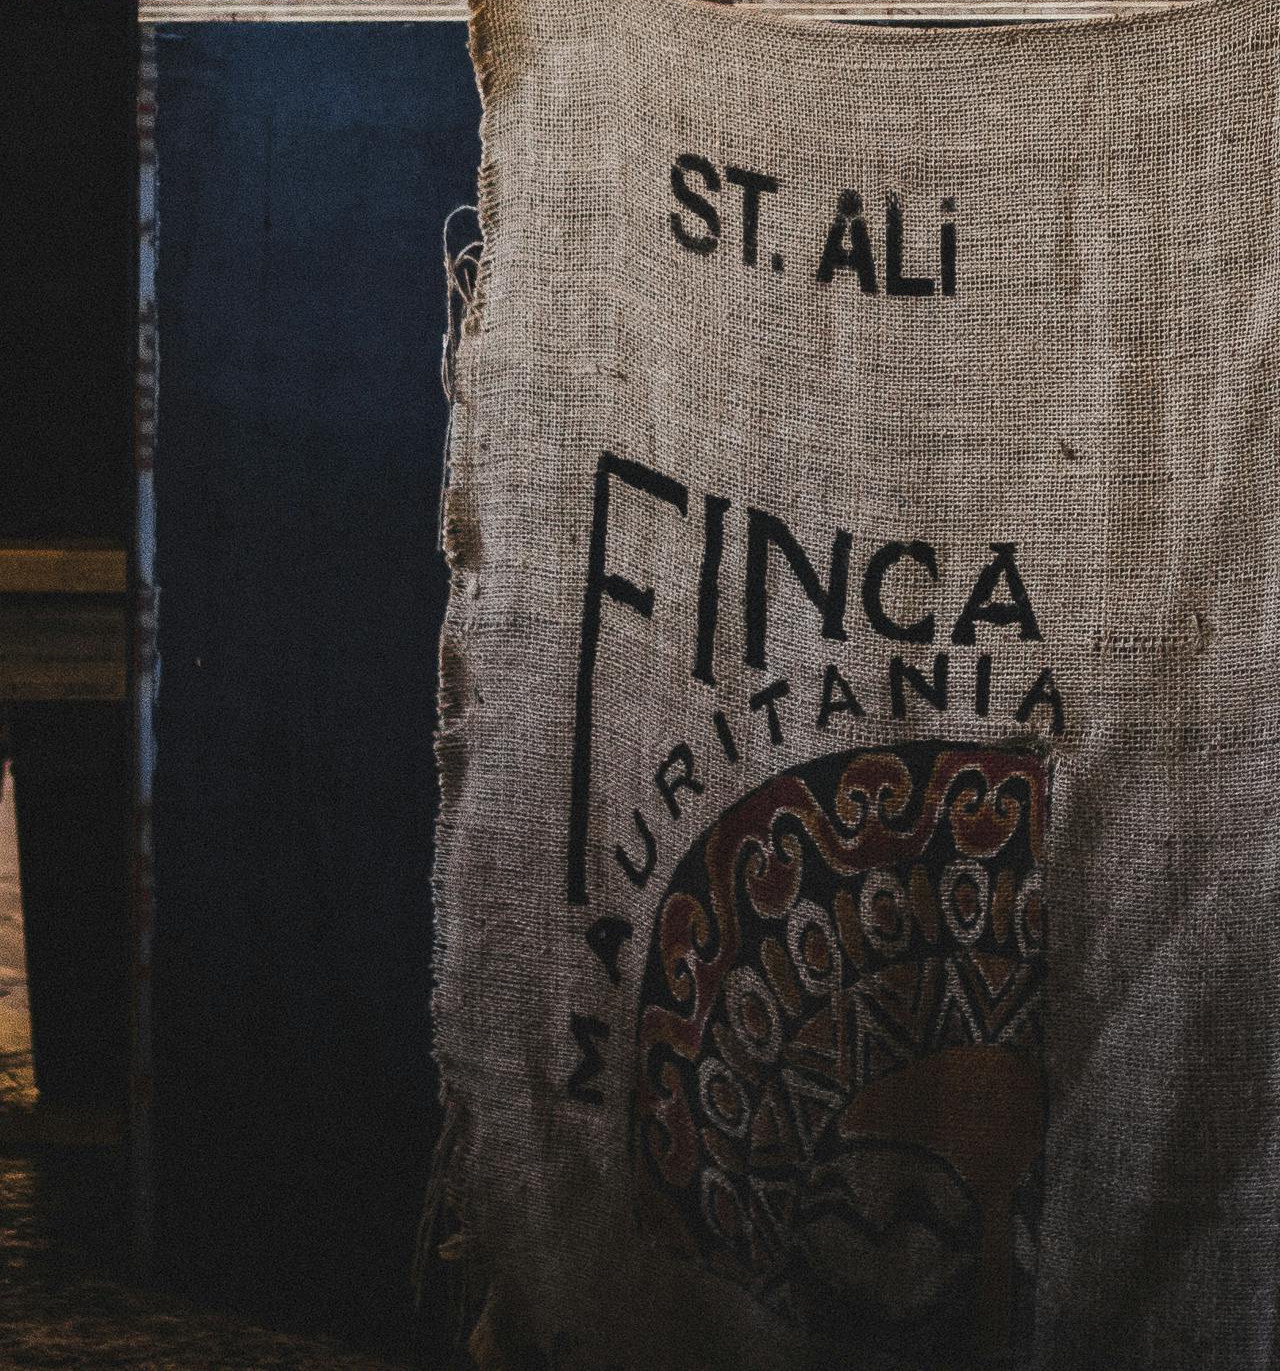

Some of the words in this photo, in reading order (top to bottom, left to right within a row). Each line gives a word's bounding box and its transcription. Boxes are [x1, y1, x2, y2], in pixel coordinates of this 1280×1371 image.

[669, 152, 785, 274] ST.
[567, 451, 1045, 906] FINCA
[568, 654, 1066, 1105] MAURITANIA
